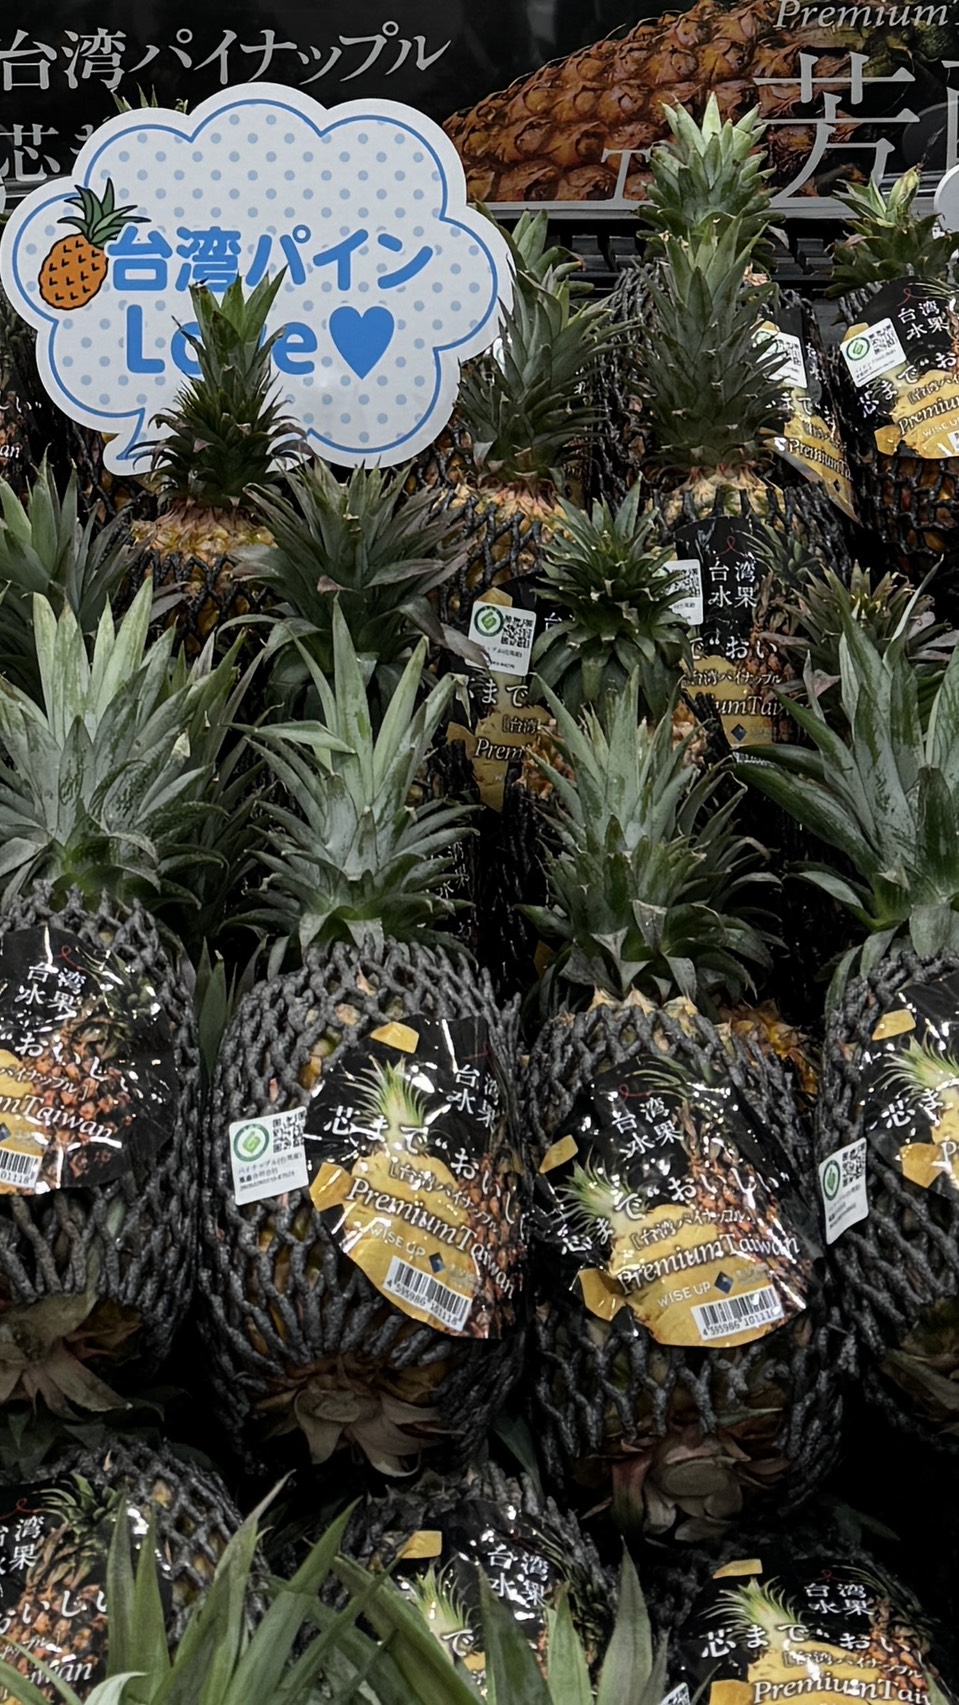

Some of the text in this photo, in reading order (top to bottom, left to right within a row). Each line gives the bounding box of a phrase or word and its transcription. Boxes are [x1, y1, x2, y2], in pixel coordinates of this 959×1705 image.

[773, 0, 959, 29] Premium
[0, 20, 452, 91] 台湾パイナップル
[600, 148, 653, 201] T
[108, 224, 433, 292] 台湾パイン
[898, 300, 941, 325] 台湾
[126, 304, 318, 375] Loe
[905, 316, 950, 342] 水果
[898, 396, 959, 435] Premiu
[708, 560, 757, 583] 台湾
[707, 586, 757, 608] 水果
[474, 737, 530, 761] Prem
[25, 962, 87, 996] 台湾
[13, 984, 77, 1013] 水果
[611, 1097, 670, 1134] 台湾
[619, 1118, 682, 1161] 水果
[369, 1225, 405, 1248] WISE
[616, 1232, 801, 1296] PremiumTaiwan
[656, 1280, 712, 1308] WISE UP
[487, 1544, 549, 1581] 台湾
[489, 1572, 550, 1605] 水果
[803, 1582, 867, 1598] 台湾
[807, 1598, 877, 1616] 水果
